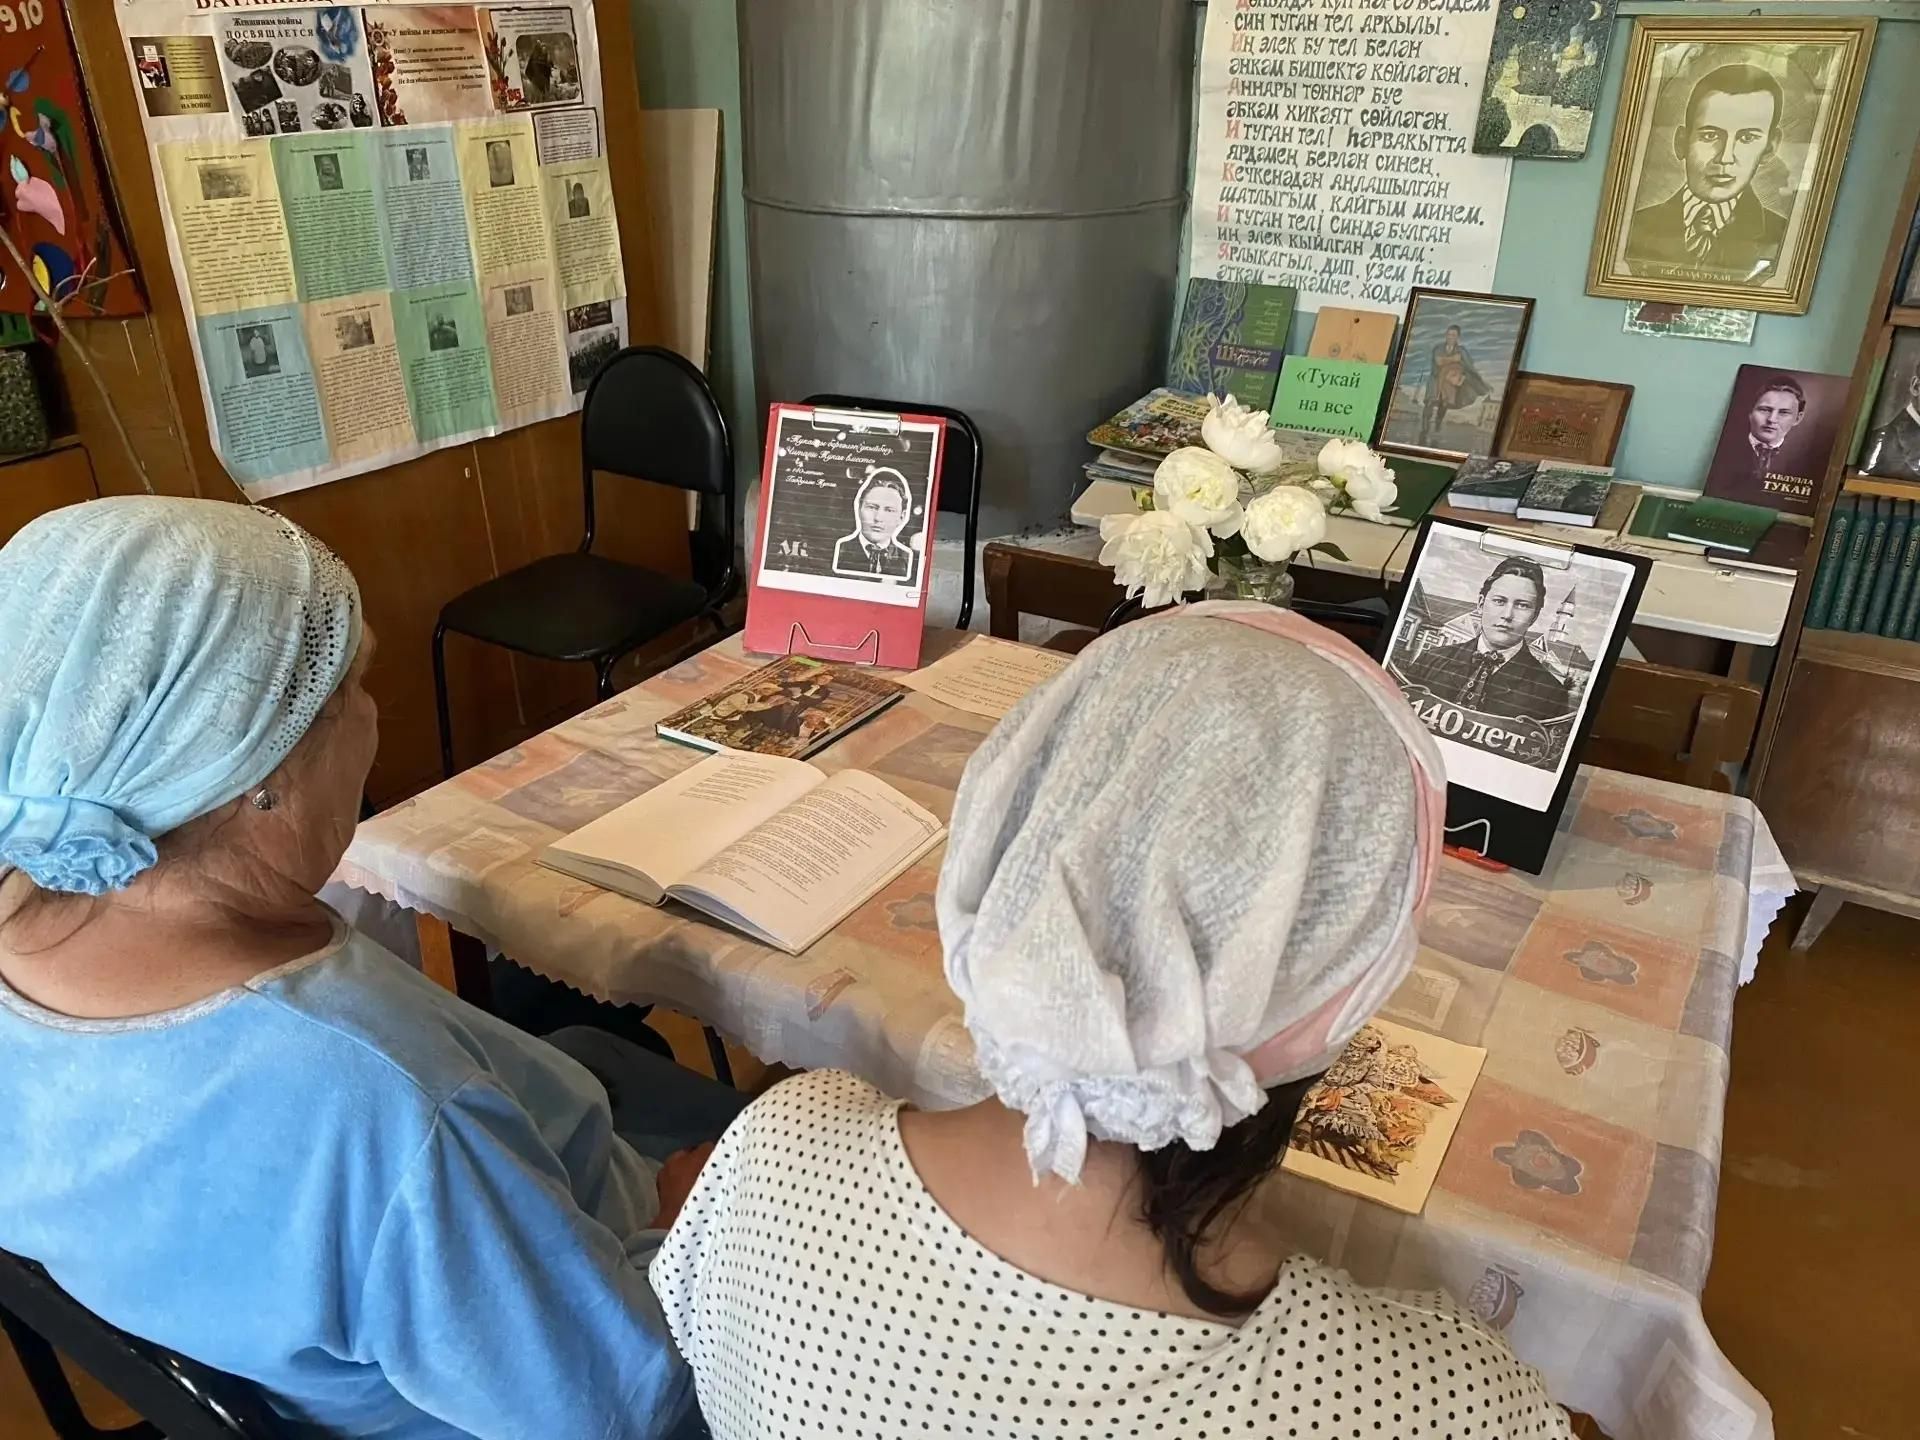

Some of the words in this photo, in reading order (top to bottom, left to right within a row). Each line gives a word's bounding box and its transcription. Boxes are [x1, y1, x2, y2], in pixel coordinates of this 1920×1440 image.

[226, 29, 314, 39] ПОСВЯЩАЕТСЯ
[1296, 367, 1361, 389] «Тукай
[1299, 399, 1318, 412] на
[1323, 402, 1353, 415] все
[1765, 472, 1814, 486] ГАБДУЛЛА
[1763, 480, 1812, 496] ТУКАЙ
[1462, 720, 1526, 754] лет
